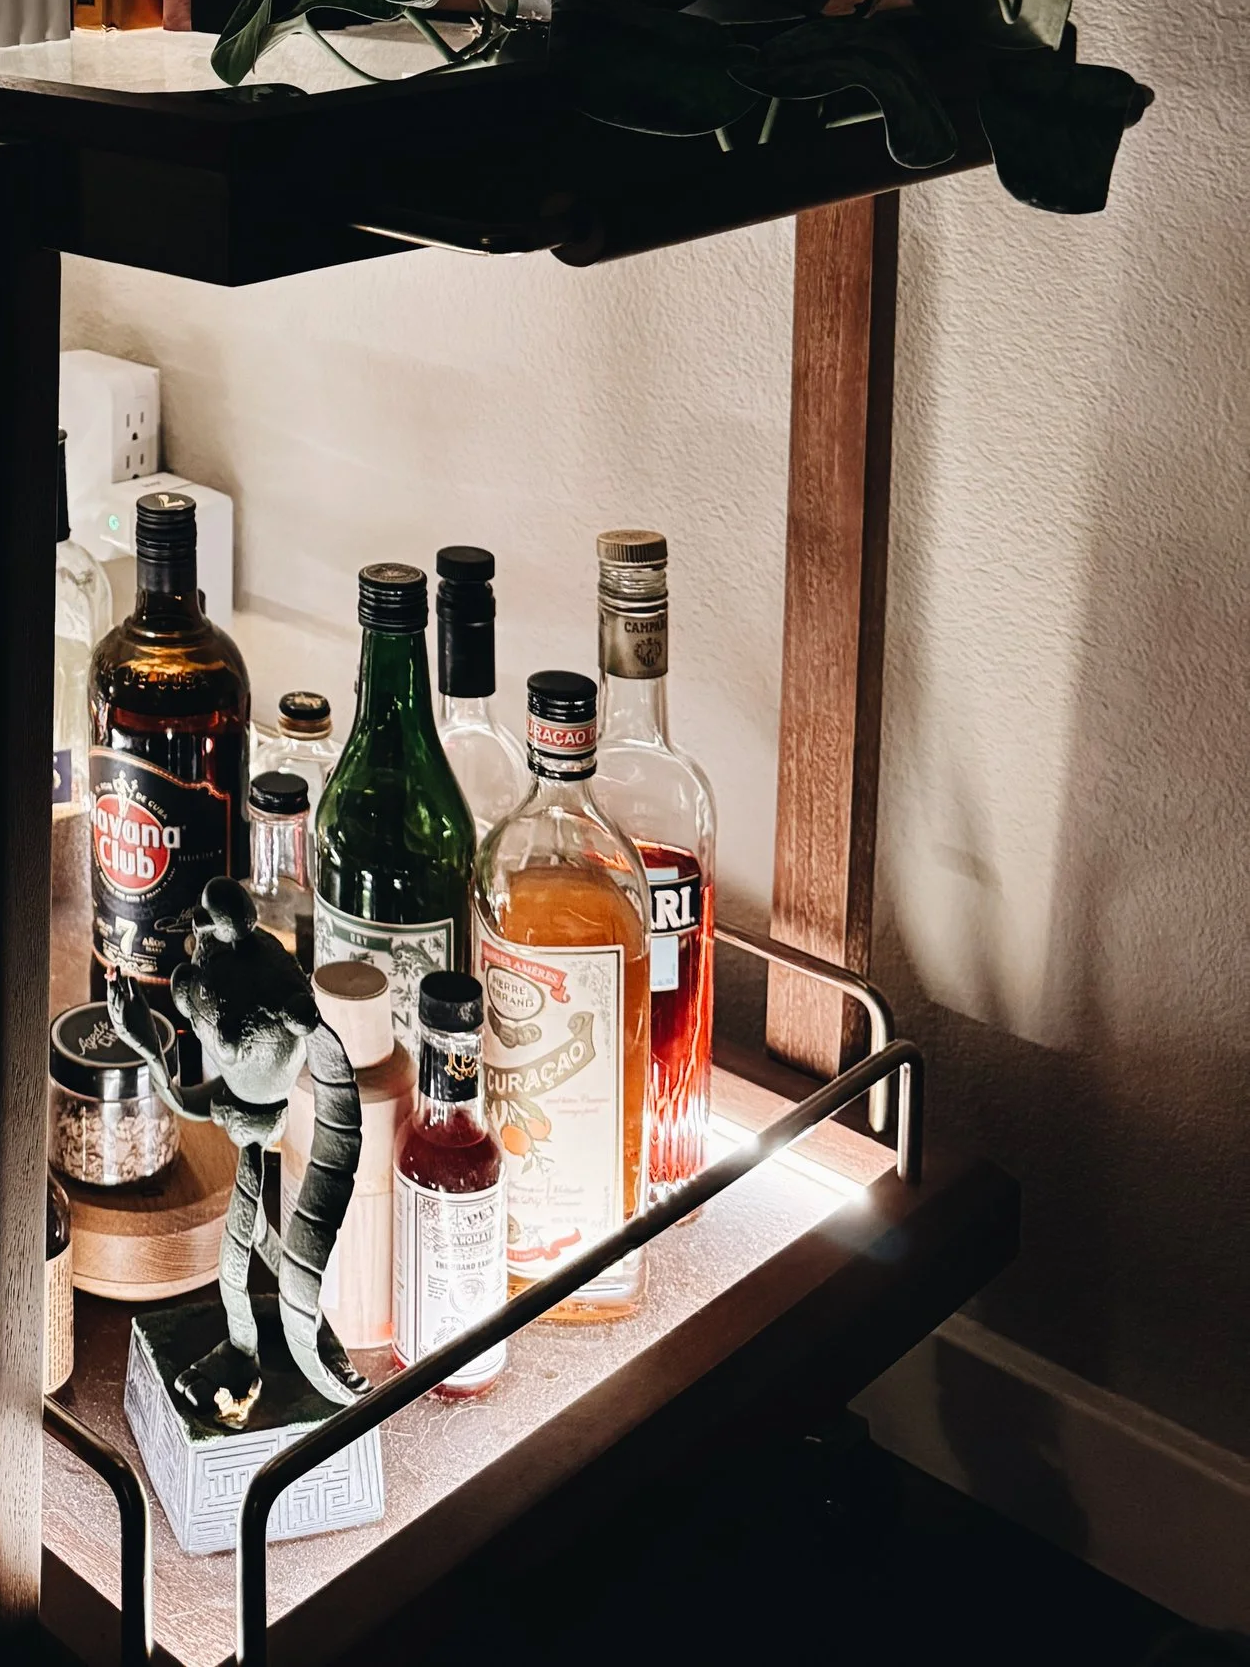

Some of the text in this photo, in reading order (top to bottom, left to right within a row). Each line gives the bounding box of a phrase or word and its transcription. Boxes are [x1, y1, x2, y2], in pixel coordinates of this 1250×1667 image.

[527, 718, 586, 746] URAÇAO
[99, 834, 155, 880] Club
[115, 915, 138, 956] 7
[486, 1039, 586, 1096] CURAÇAO
